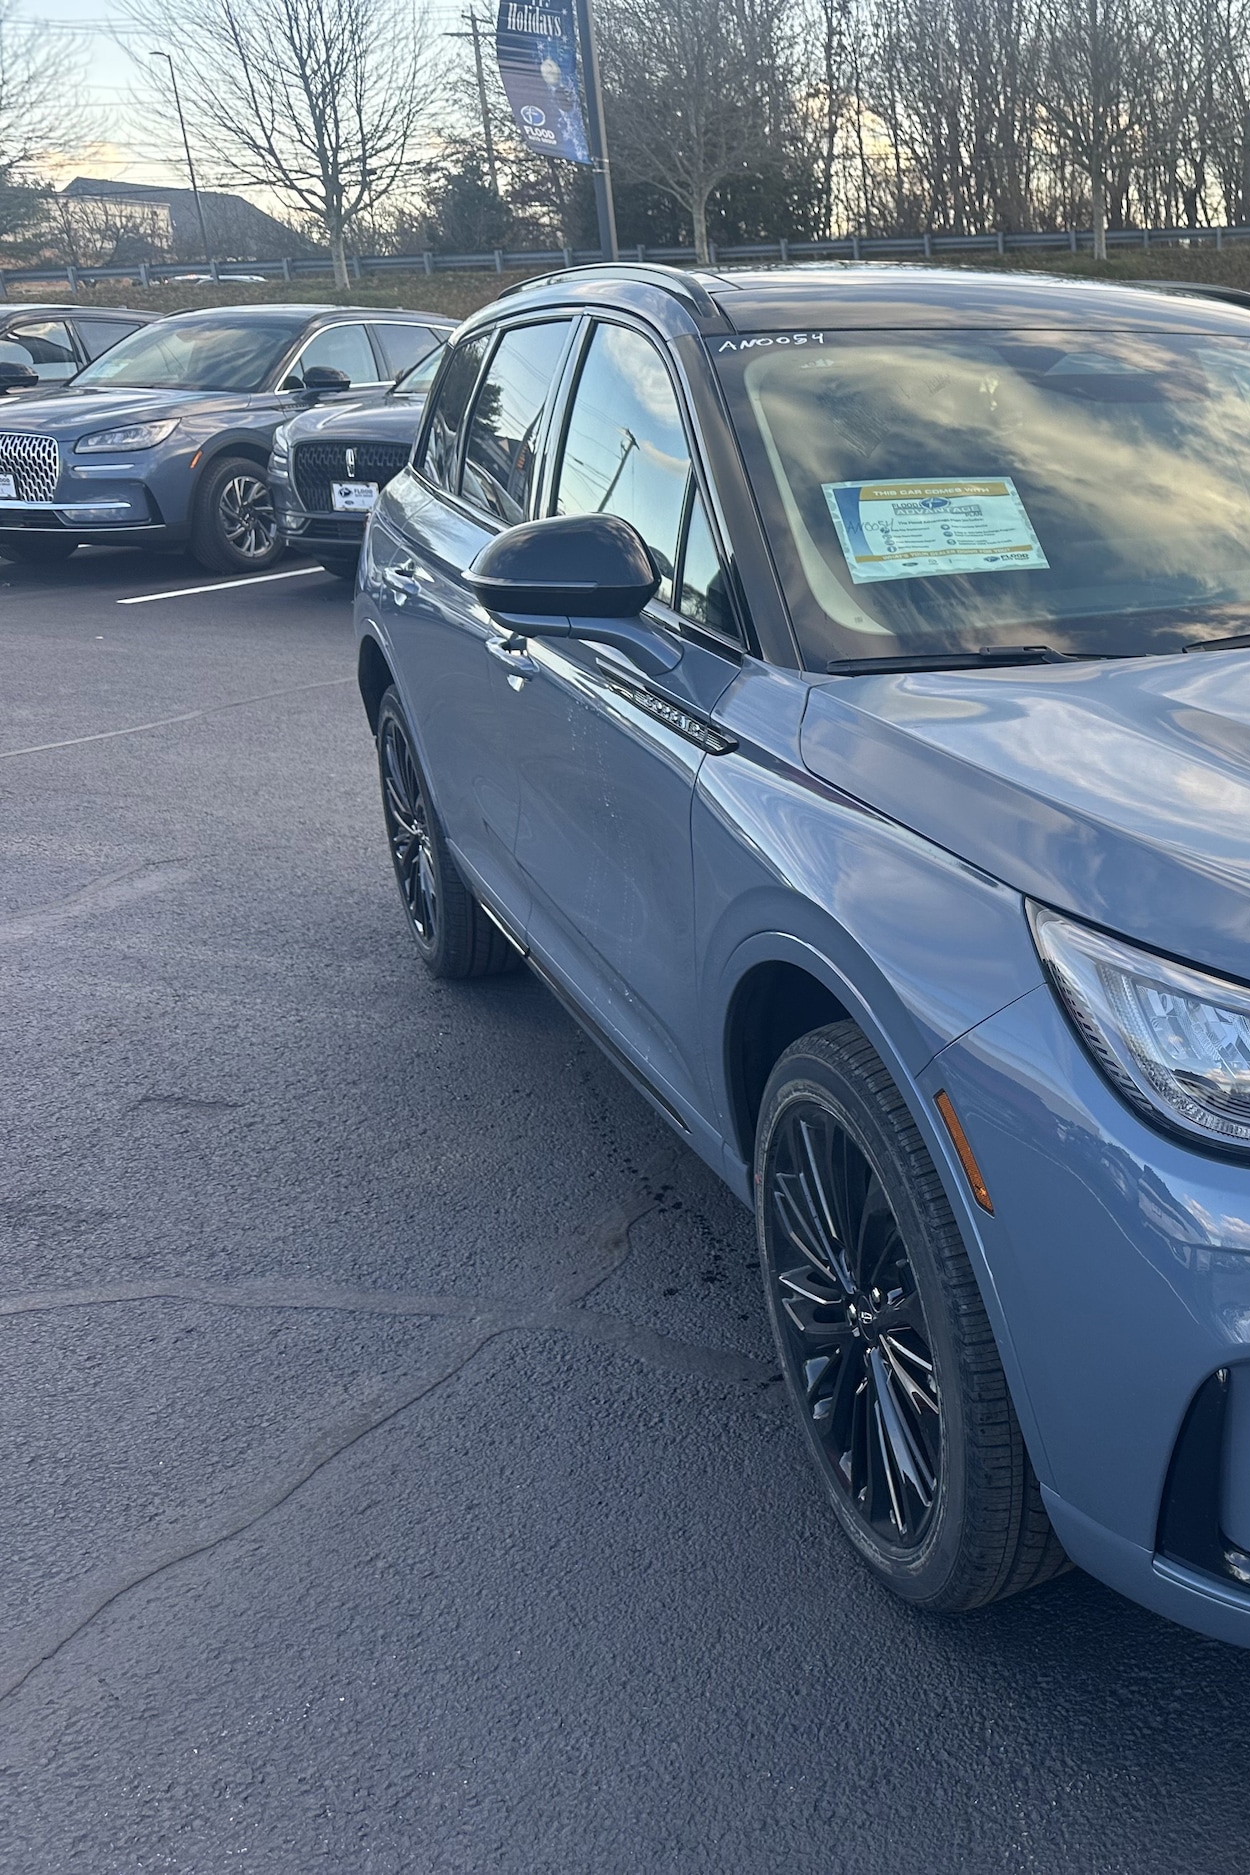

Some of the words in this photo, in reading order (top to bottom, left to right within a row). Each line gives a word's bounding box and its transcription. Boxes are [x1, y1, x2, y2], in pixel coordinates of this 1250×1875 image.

[507, 2, 562, 41] Holidays
[523, 125, 555, 139] FLOOD
[924, 487, 962, 495] COMES
[891, 502, 922, 510] FLOOD
[894, 504, 981, 515] ADVANTAGE
